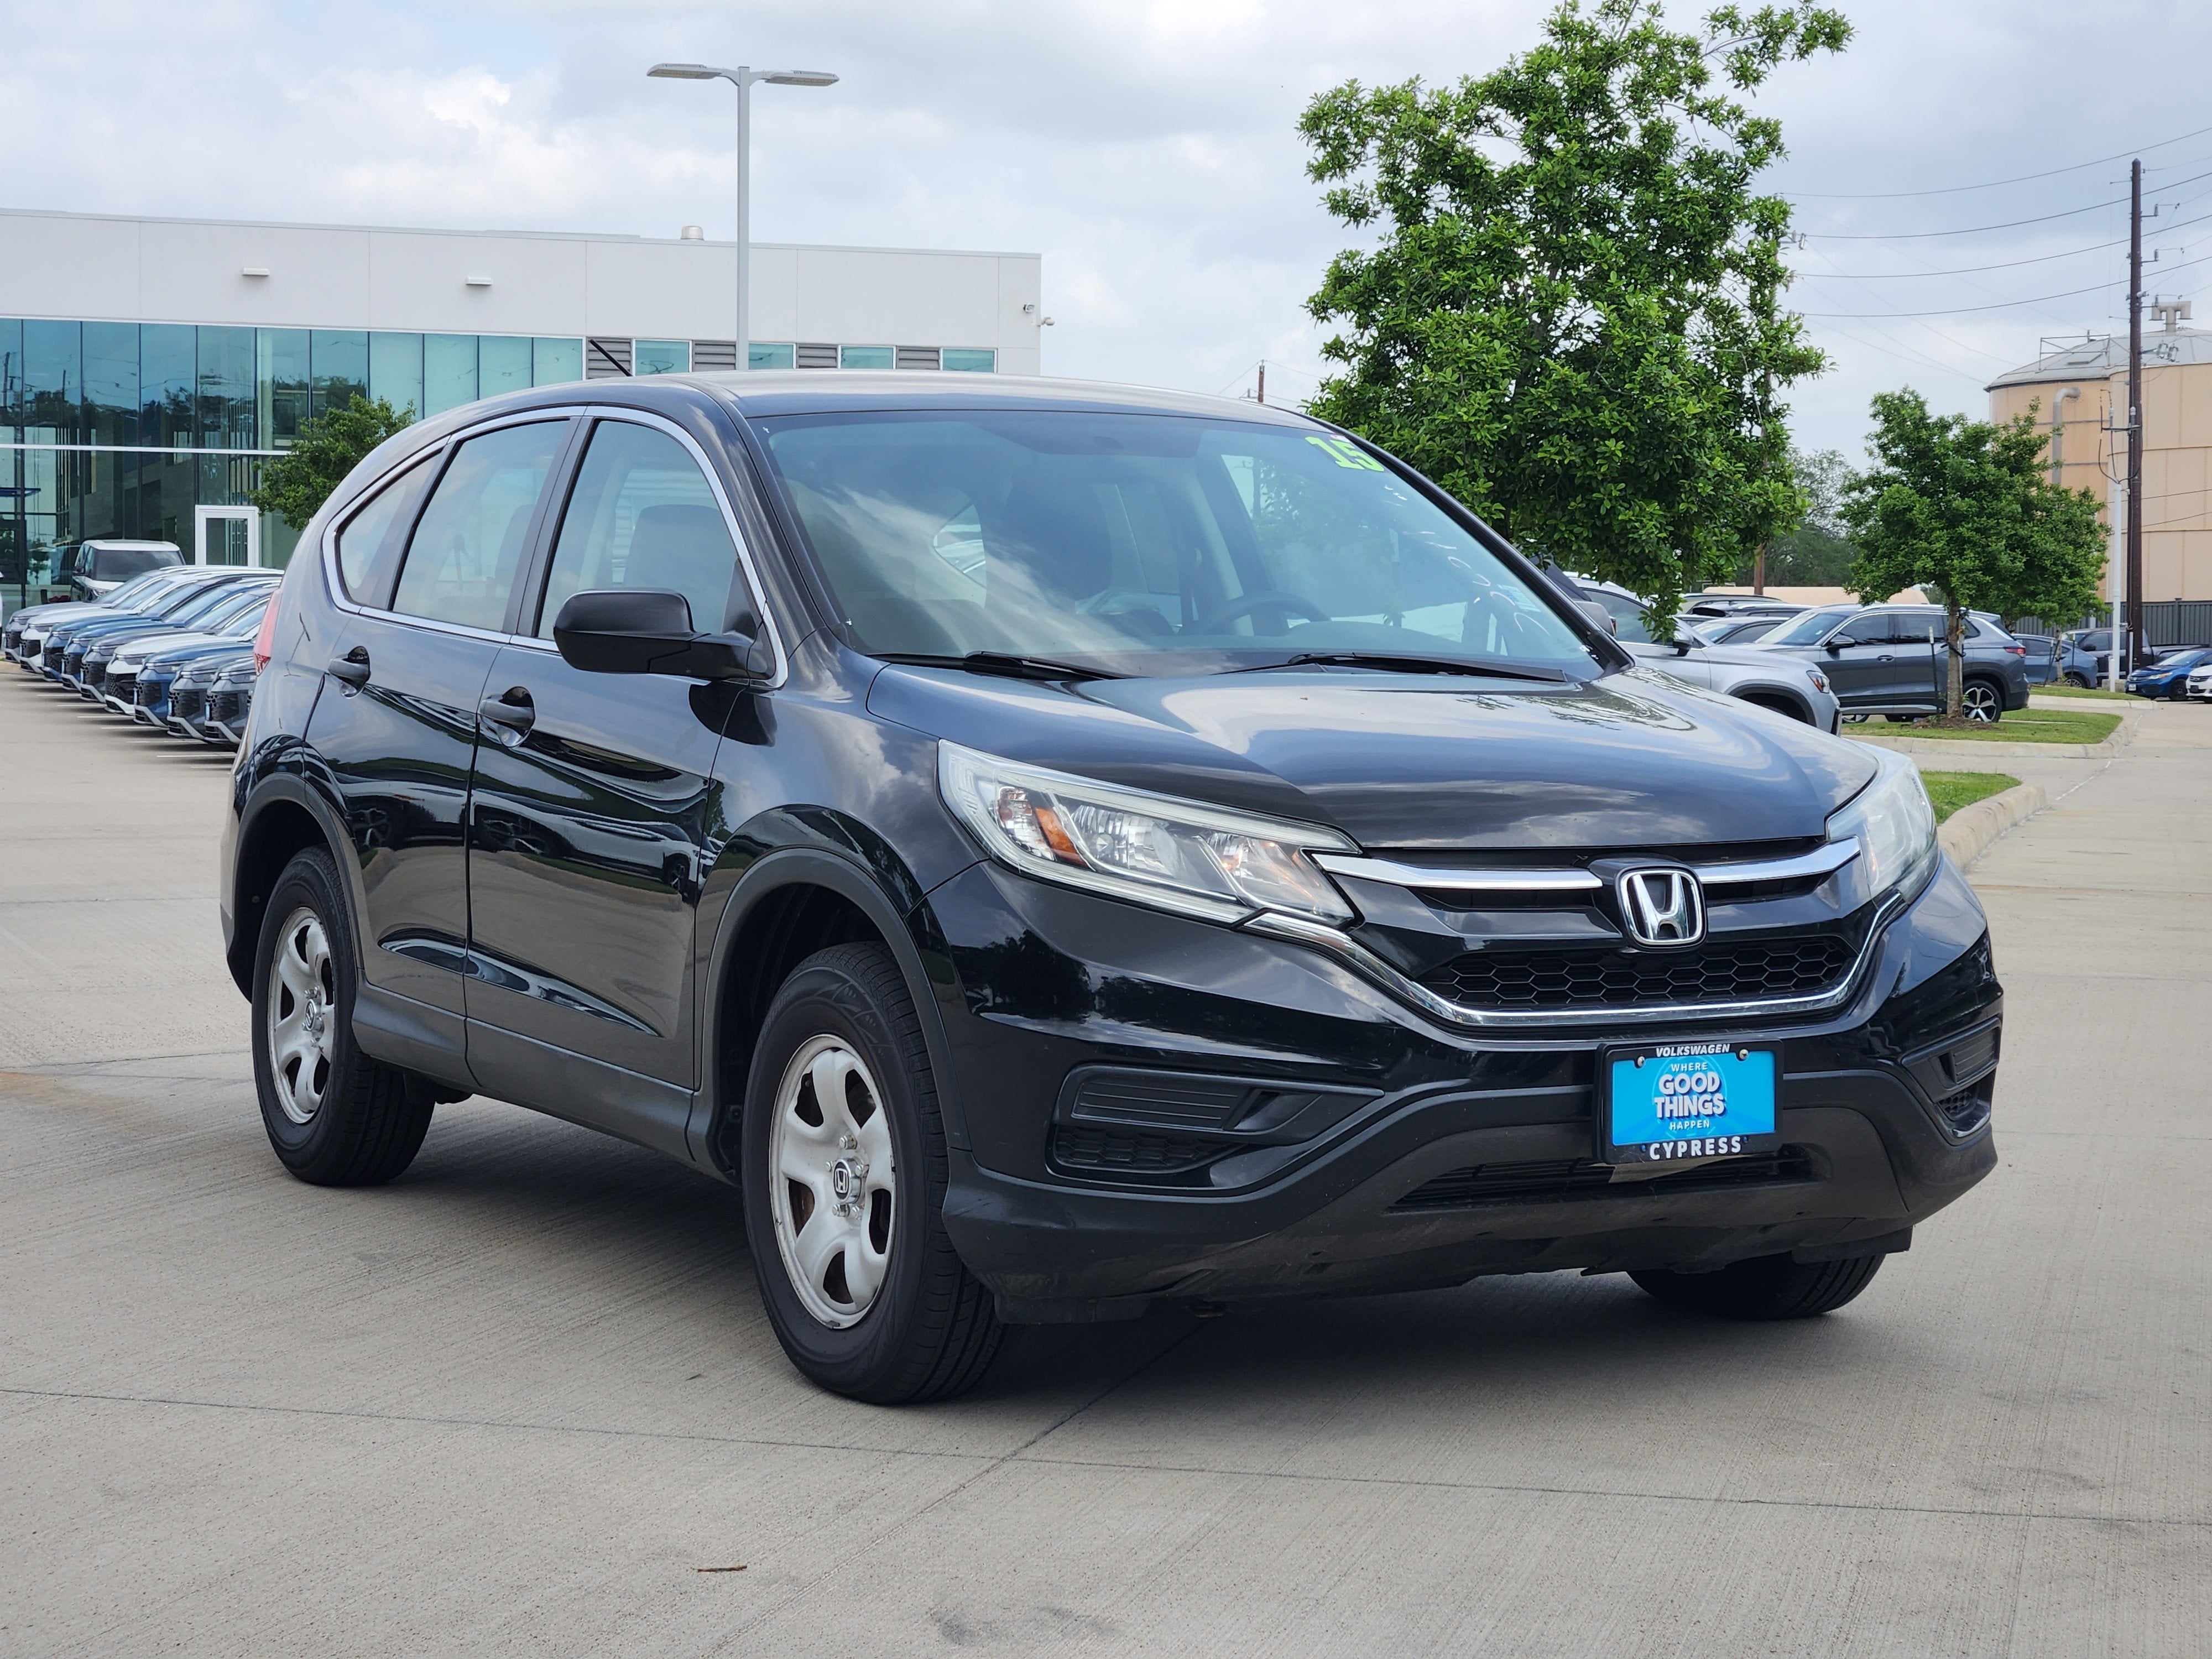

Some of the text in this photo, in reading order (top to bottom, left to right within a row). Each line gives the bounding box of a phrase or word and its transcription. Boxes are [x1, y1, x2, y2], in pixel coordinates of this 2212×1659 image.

[1305, 436, 1384, 472] 15
[1656, 1044, 1730, 1057] VOLKSWAGEN
[1671, 1062, 1708, 1072] WHERE
[1659, 1072, 1721, 1095] GOOD
[1654, 1093, 1725, 1118] THINGS
[1669, 1120, 1710, 1131] HAPPEN
[1649, 1136, 1742, 1160] CYPRESS
